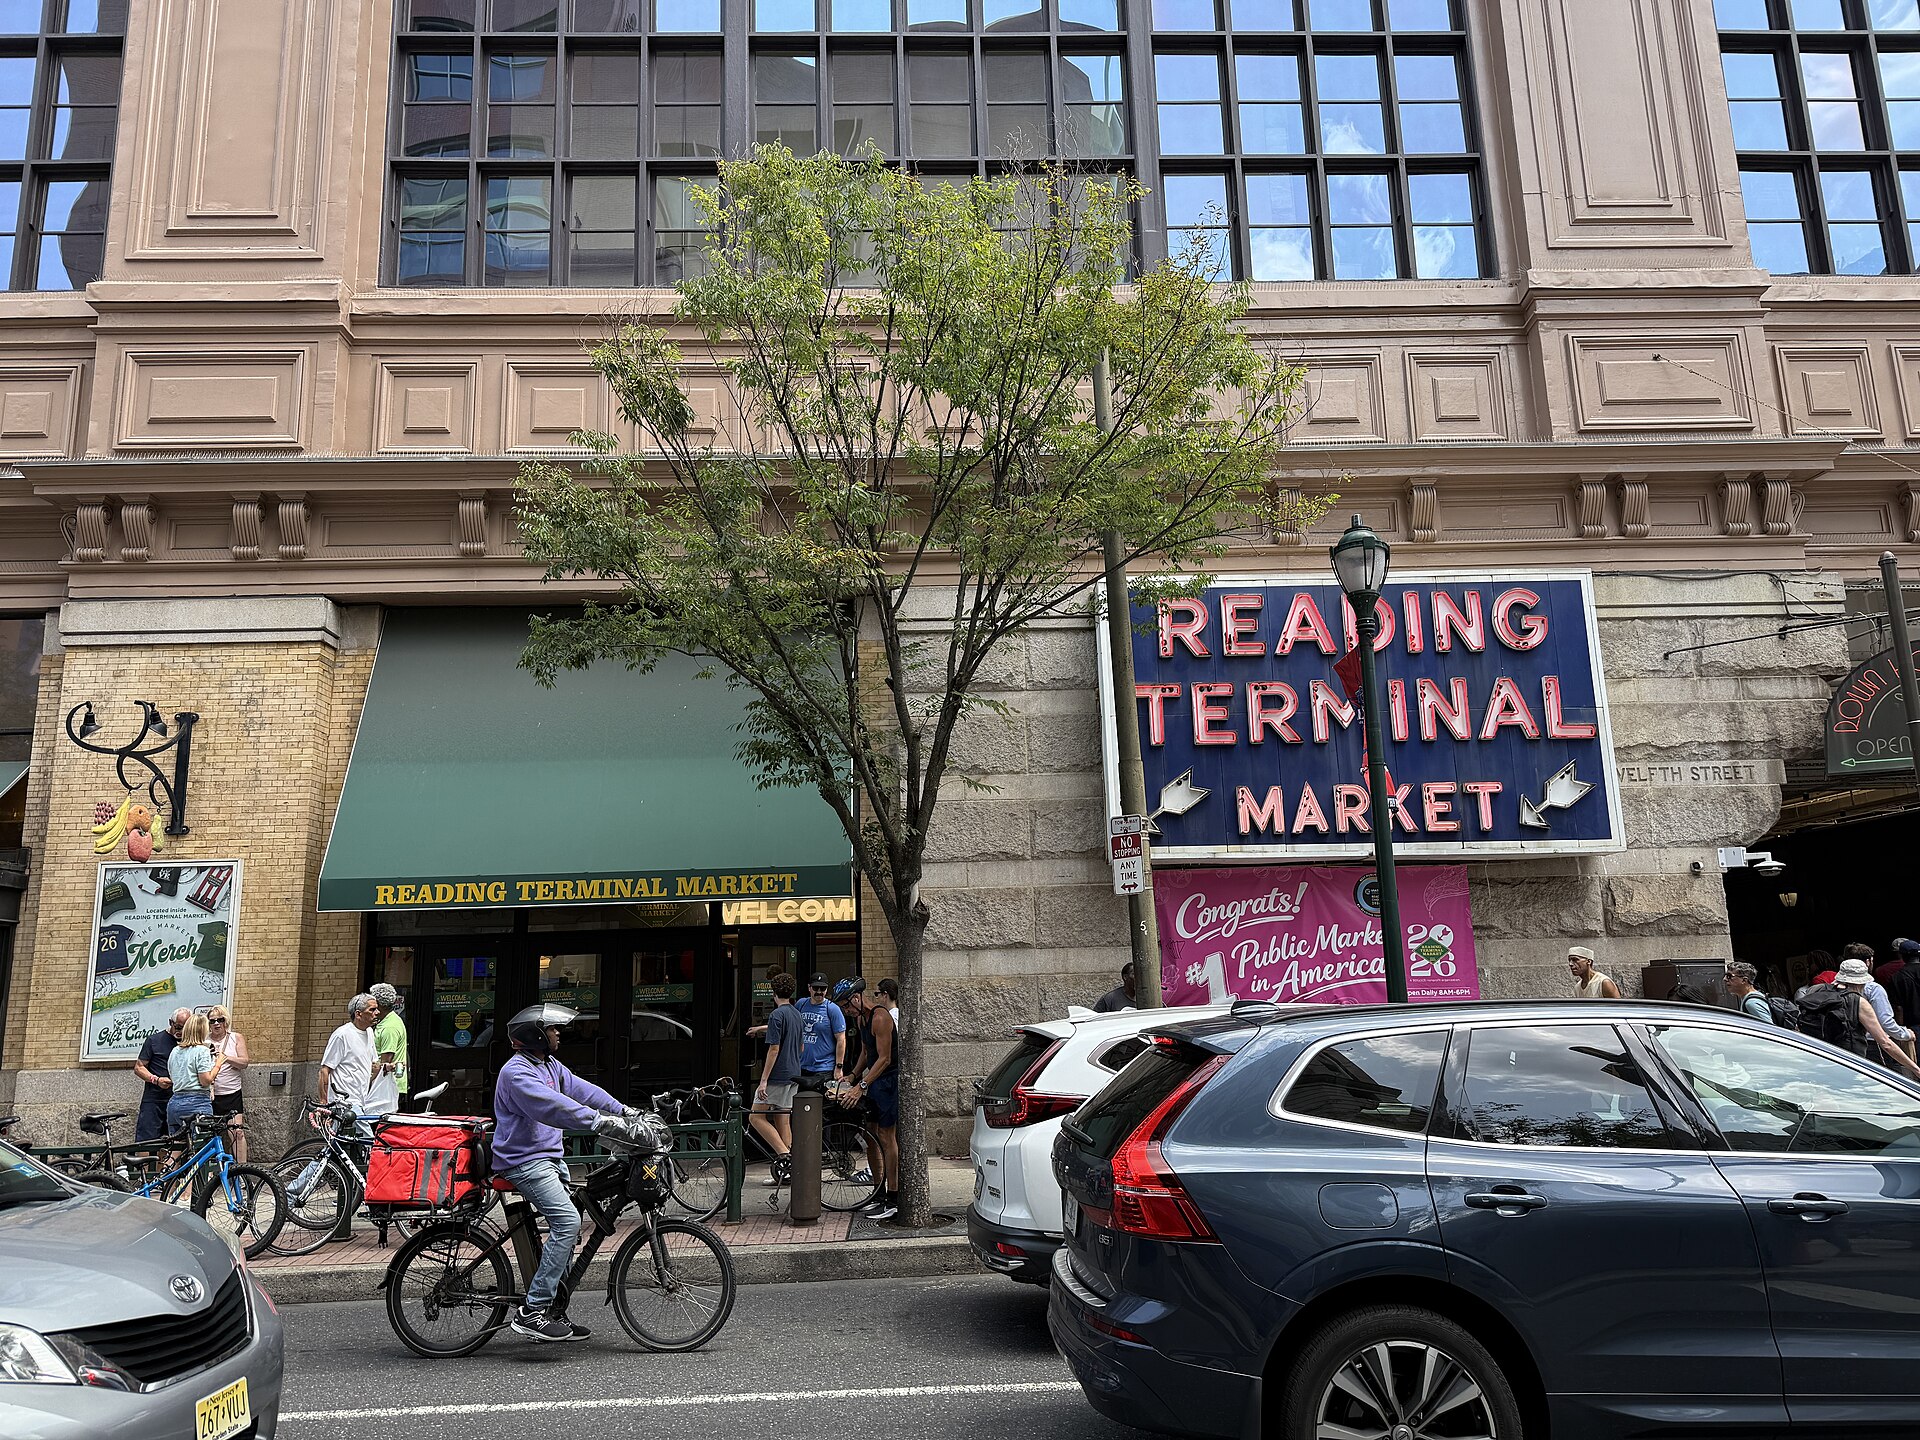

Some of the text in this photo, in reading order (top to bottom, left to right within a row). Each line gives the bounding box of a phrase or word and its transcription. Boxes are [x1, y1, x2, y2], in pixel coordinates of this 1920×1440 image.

[1157, 587, 1549, 658] READING
[1135, 675, 1598, 747] TERMINAL
[1856, 735, 1913, 756] OPEN
[1690, 765, 1755, 781] STREET
[1235, 781, 1503, 835] MARKET
[1120, 836, 1133, 848] NO
[1114, 847, 1141, 858] STOPPING
[1120, 860, 1136, 870] ANY
[1120, 871, 1138, 881] TIME
[374, 873, 798, 905] READING TERMINAL MARKET
[635, 903, 680, 911] TERMINAL
[639, 909, 677, 917] MARKET
[1175, 881, 1309, 938] Congrats!
[137, 923, 190, 939] THE MARKET
[100, 935, 118, 951] 26
[1231, 920, 1383, 979] Public Marke
[121, 936, 198, 977] Merch
[639, 986, 666, 995] WELCOME
[1250, 974, 1271, 993] in
[440, 994, 467, 1002] WELCOME
[545, 990, 572, 999] WELCOME
[1421, 989, 1437, 997] Daily
[1438, 988, 1471, 996] 8AM-6PM
[800, 1012, 824, 1024] ENTUCKY
[97, 1027, 122, 1047] Gift
[209, 1387, 235, 1406] New Jersey
[227, 1423, 239, 1433] State
